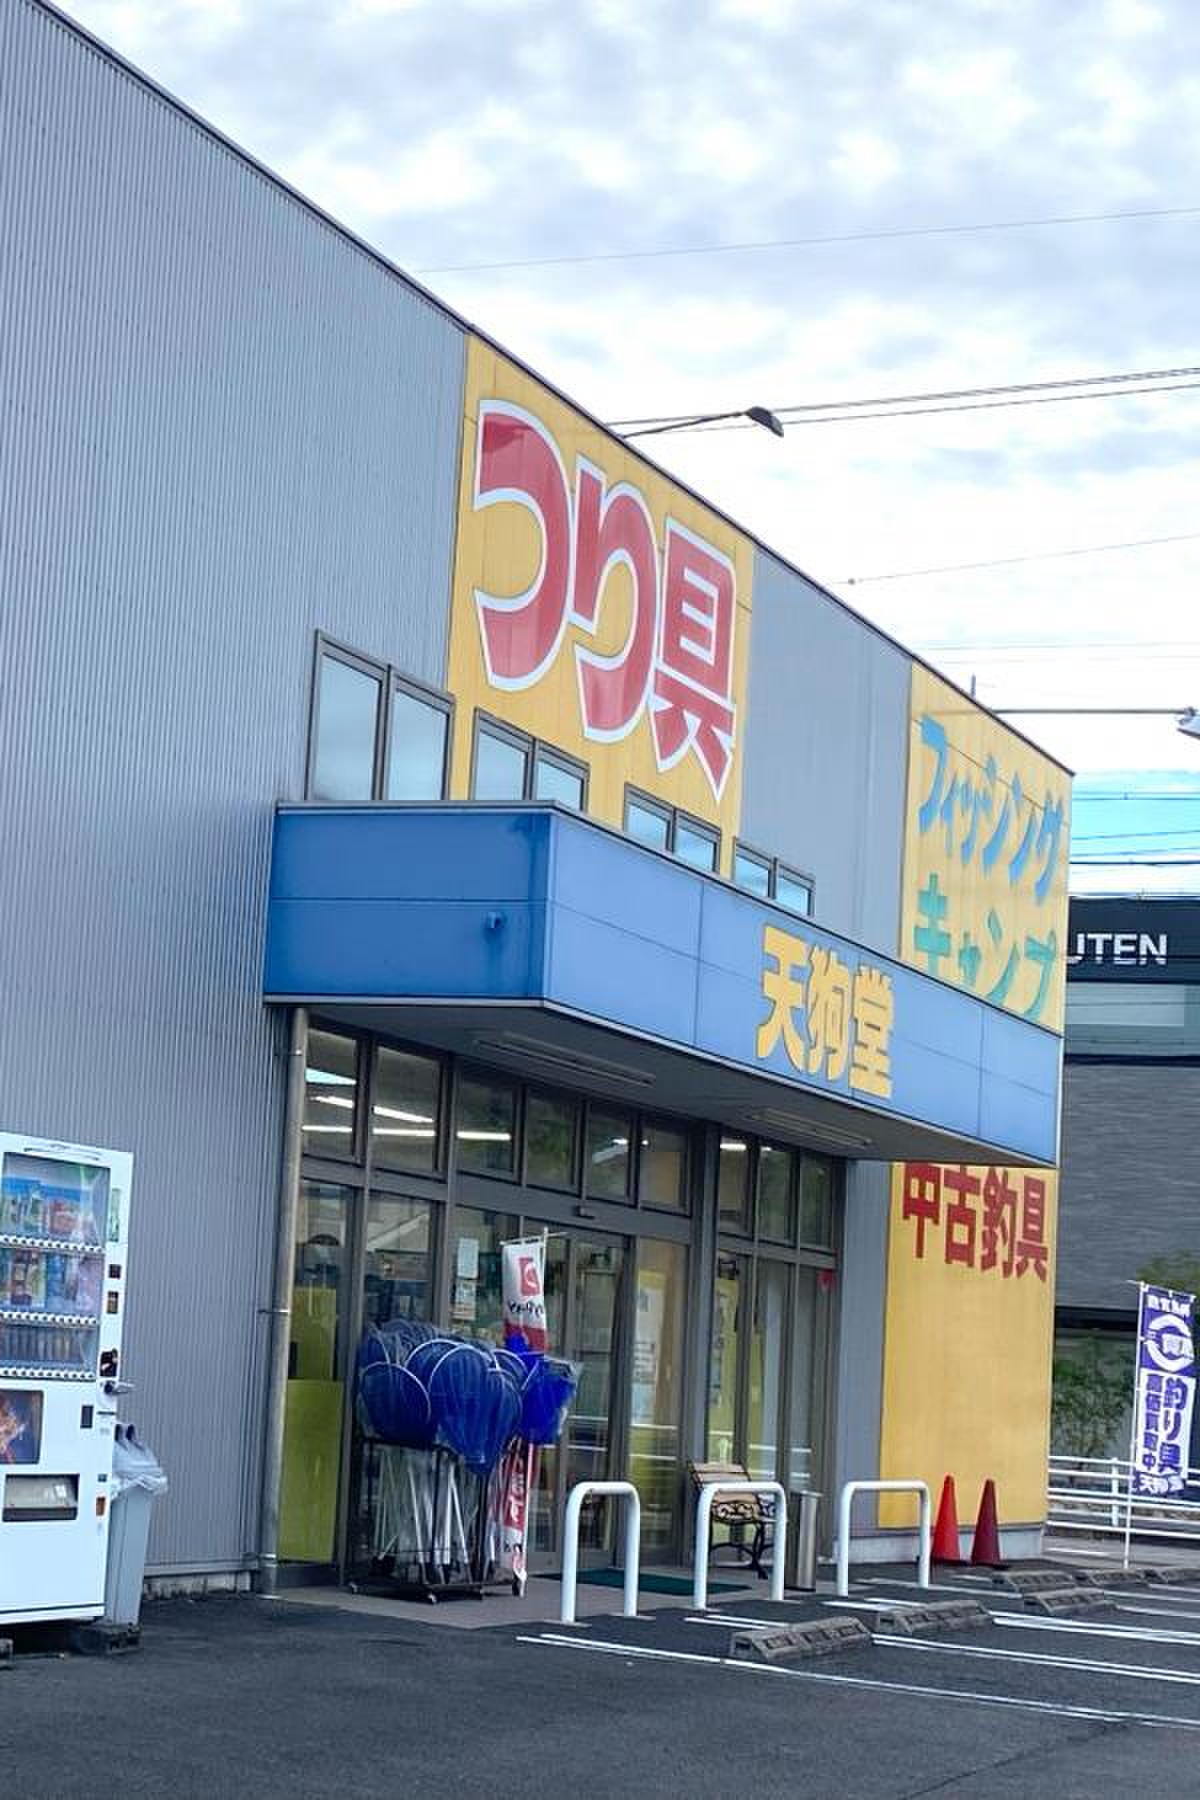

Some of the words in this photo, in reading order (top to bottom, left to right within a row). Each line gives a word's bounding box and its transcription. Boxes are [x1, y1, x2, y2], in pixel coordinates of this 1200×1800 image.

[474, 399, 737, 802] つり具
[919, 714, 1063, 906] フィッシング
[757, 925, 893, 1098] 天狗堂
[913, 873, 1057, 1018] キャンプ
[903, 1162, 1048, 1283] 中古釣具
